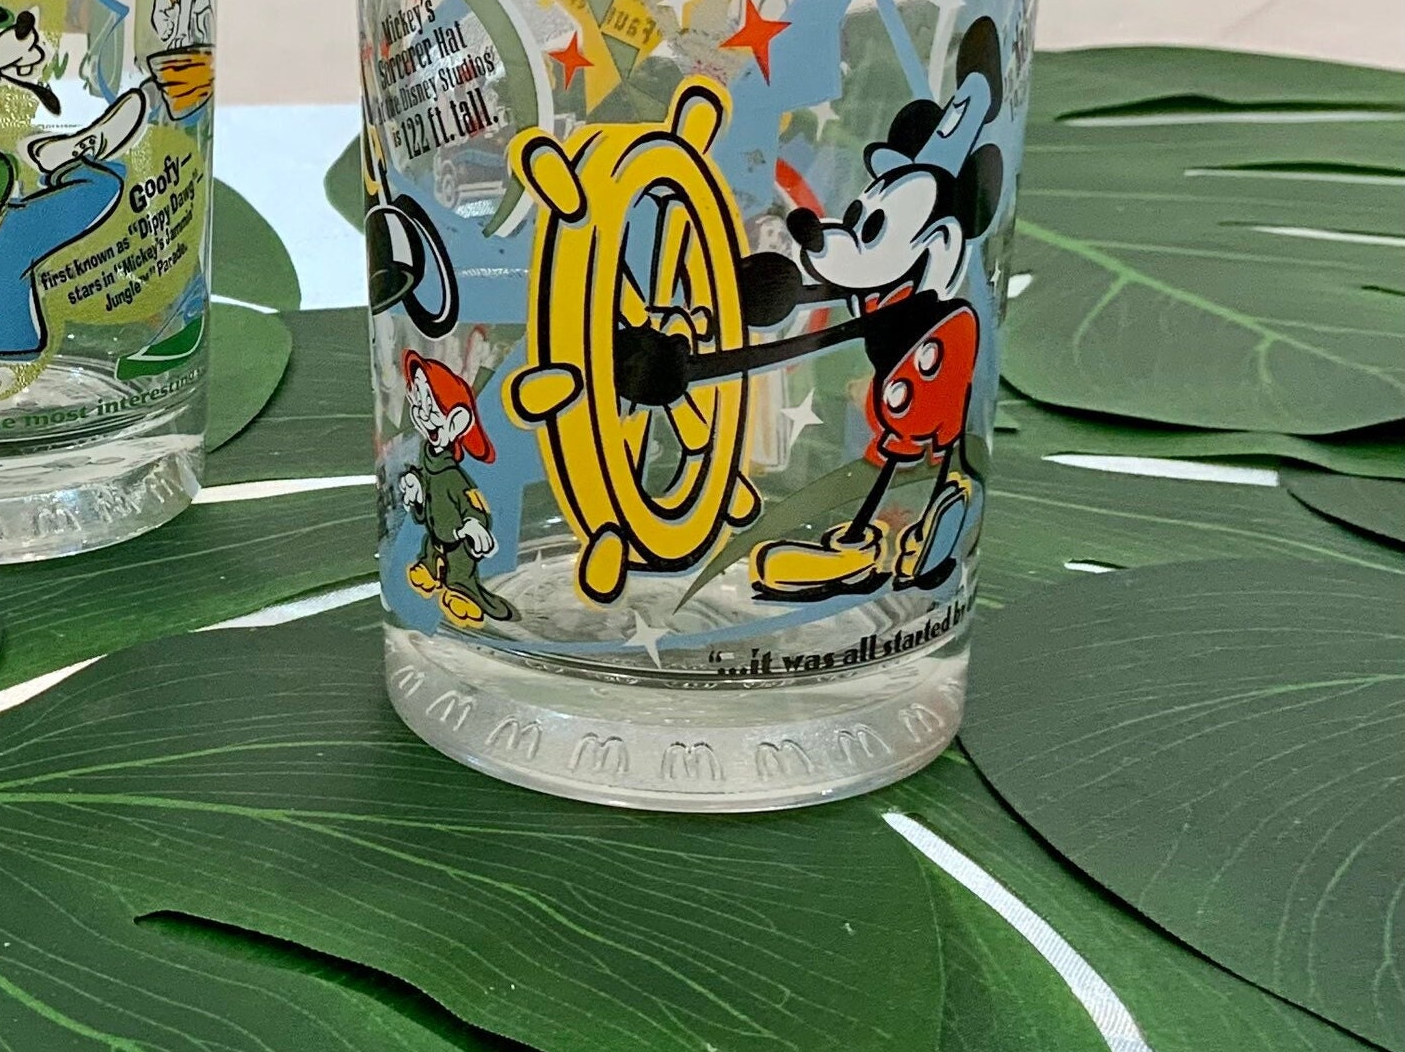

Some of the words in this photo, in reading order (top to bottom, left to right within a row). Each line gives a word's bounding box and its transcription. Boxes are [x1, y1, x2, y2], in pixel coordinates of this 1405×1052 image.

[433, 20, 468, 59] Hat
[401, 113, 432, 160] 122
[450, 87, 500, 138] tall.
[40, 265, 75, 290] first
[74, 246, 115, 276] known
[115, 236, 130, 255] as
[67, 278, 103, 305] stars
[103, 271, 116, 288] in
[24, 405, 89, 428] most
[782, 650, 835, 673] was
[842, 633, 877, 666] all
[882, 604, 951, 658] started
